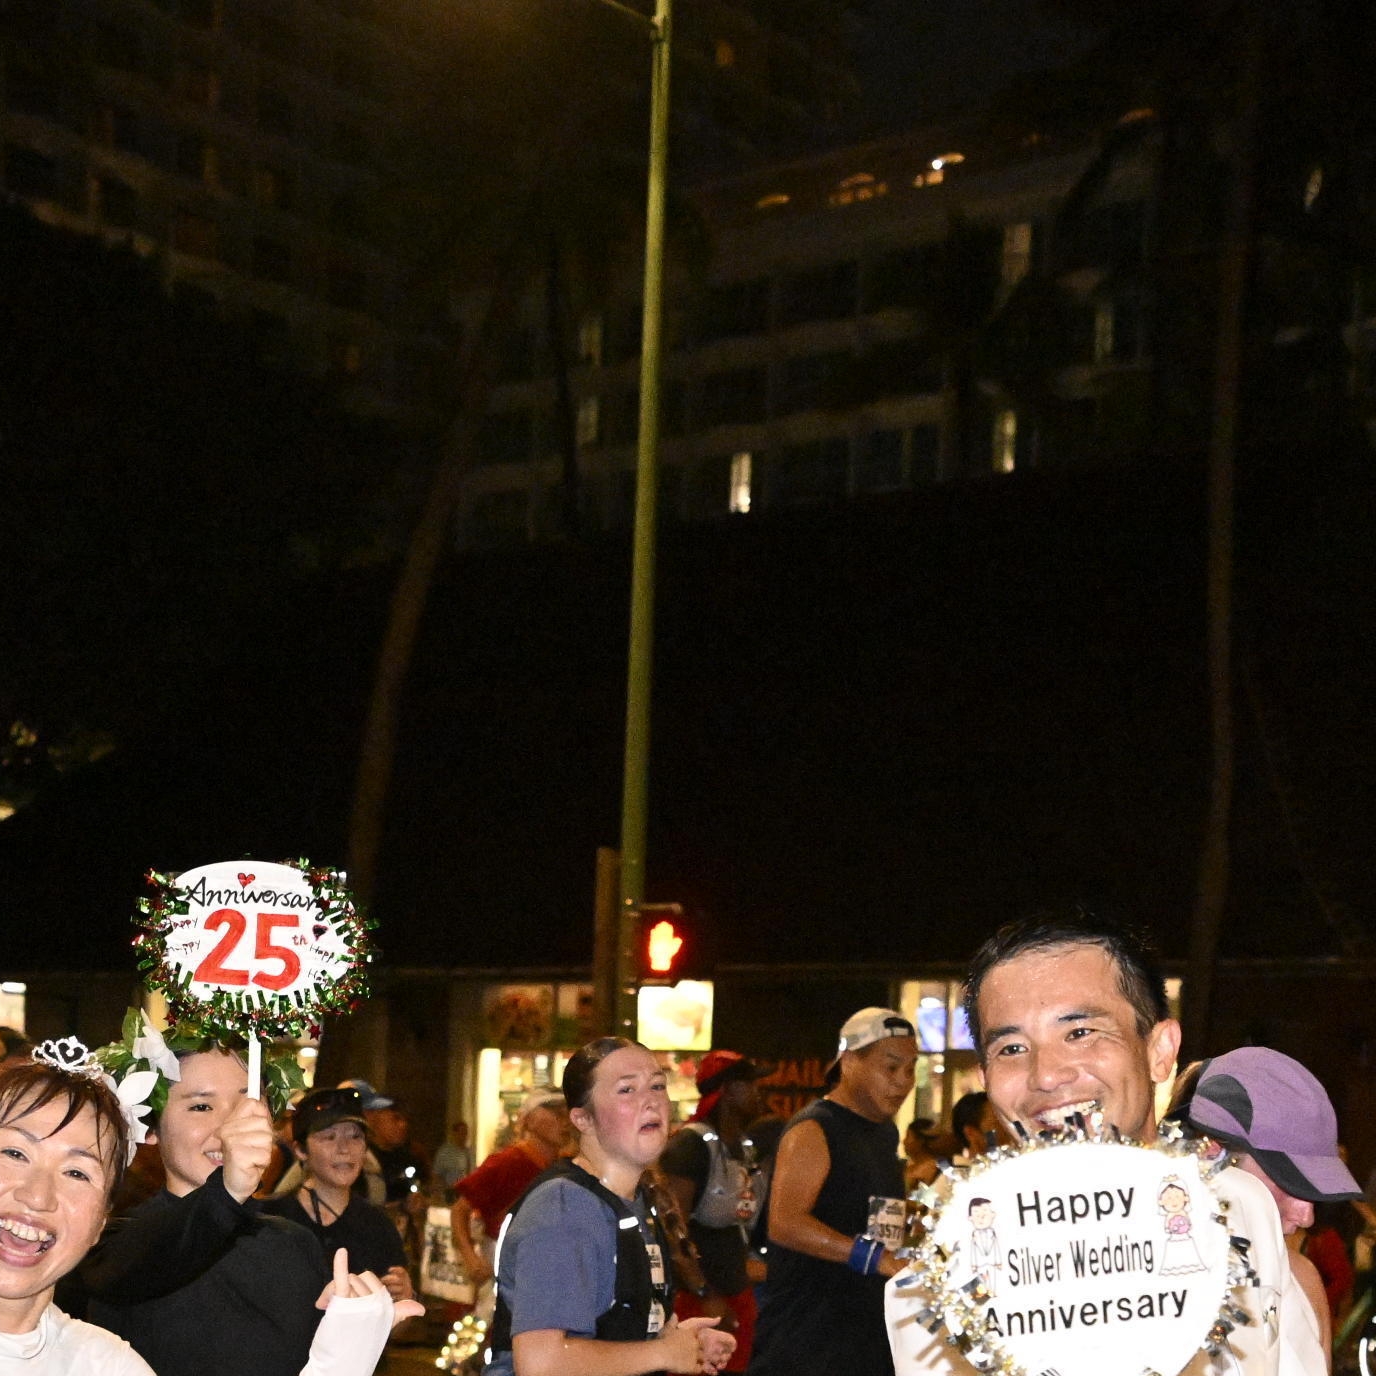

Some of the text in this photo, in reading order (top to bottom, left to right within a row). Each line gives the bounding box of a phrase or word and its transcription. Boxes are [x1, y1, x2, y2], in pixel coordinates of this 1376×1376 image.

[1016, 1186, 1135, 1228] Happy
[1007, 1234, 1155, 1287] Silver Wedding
[984, 1289, 1188, 1339] Anniversary
